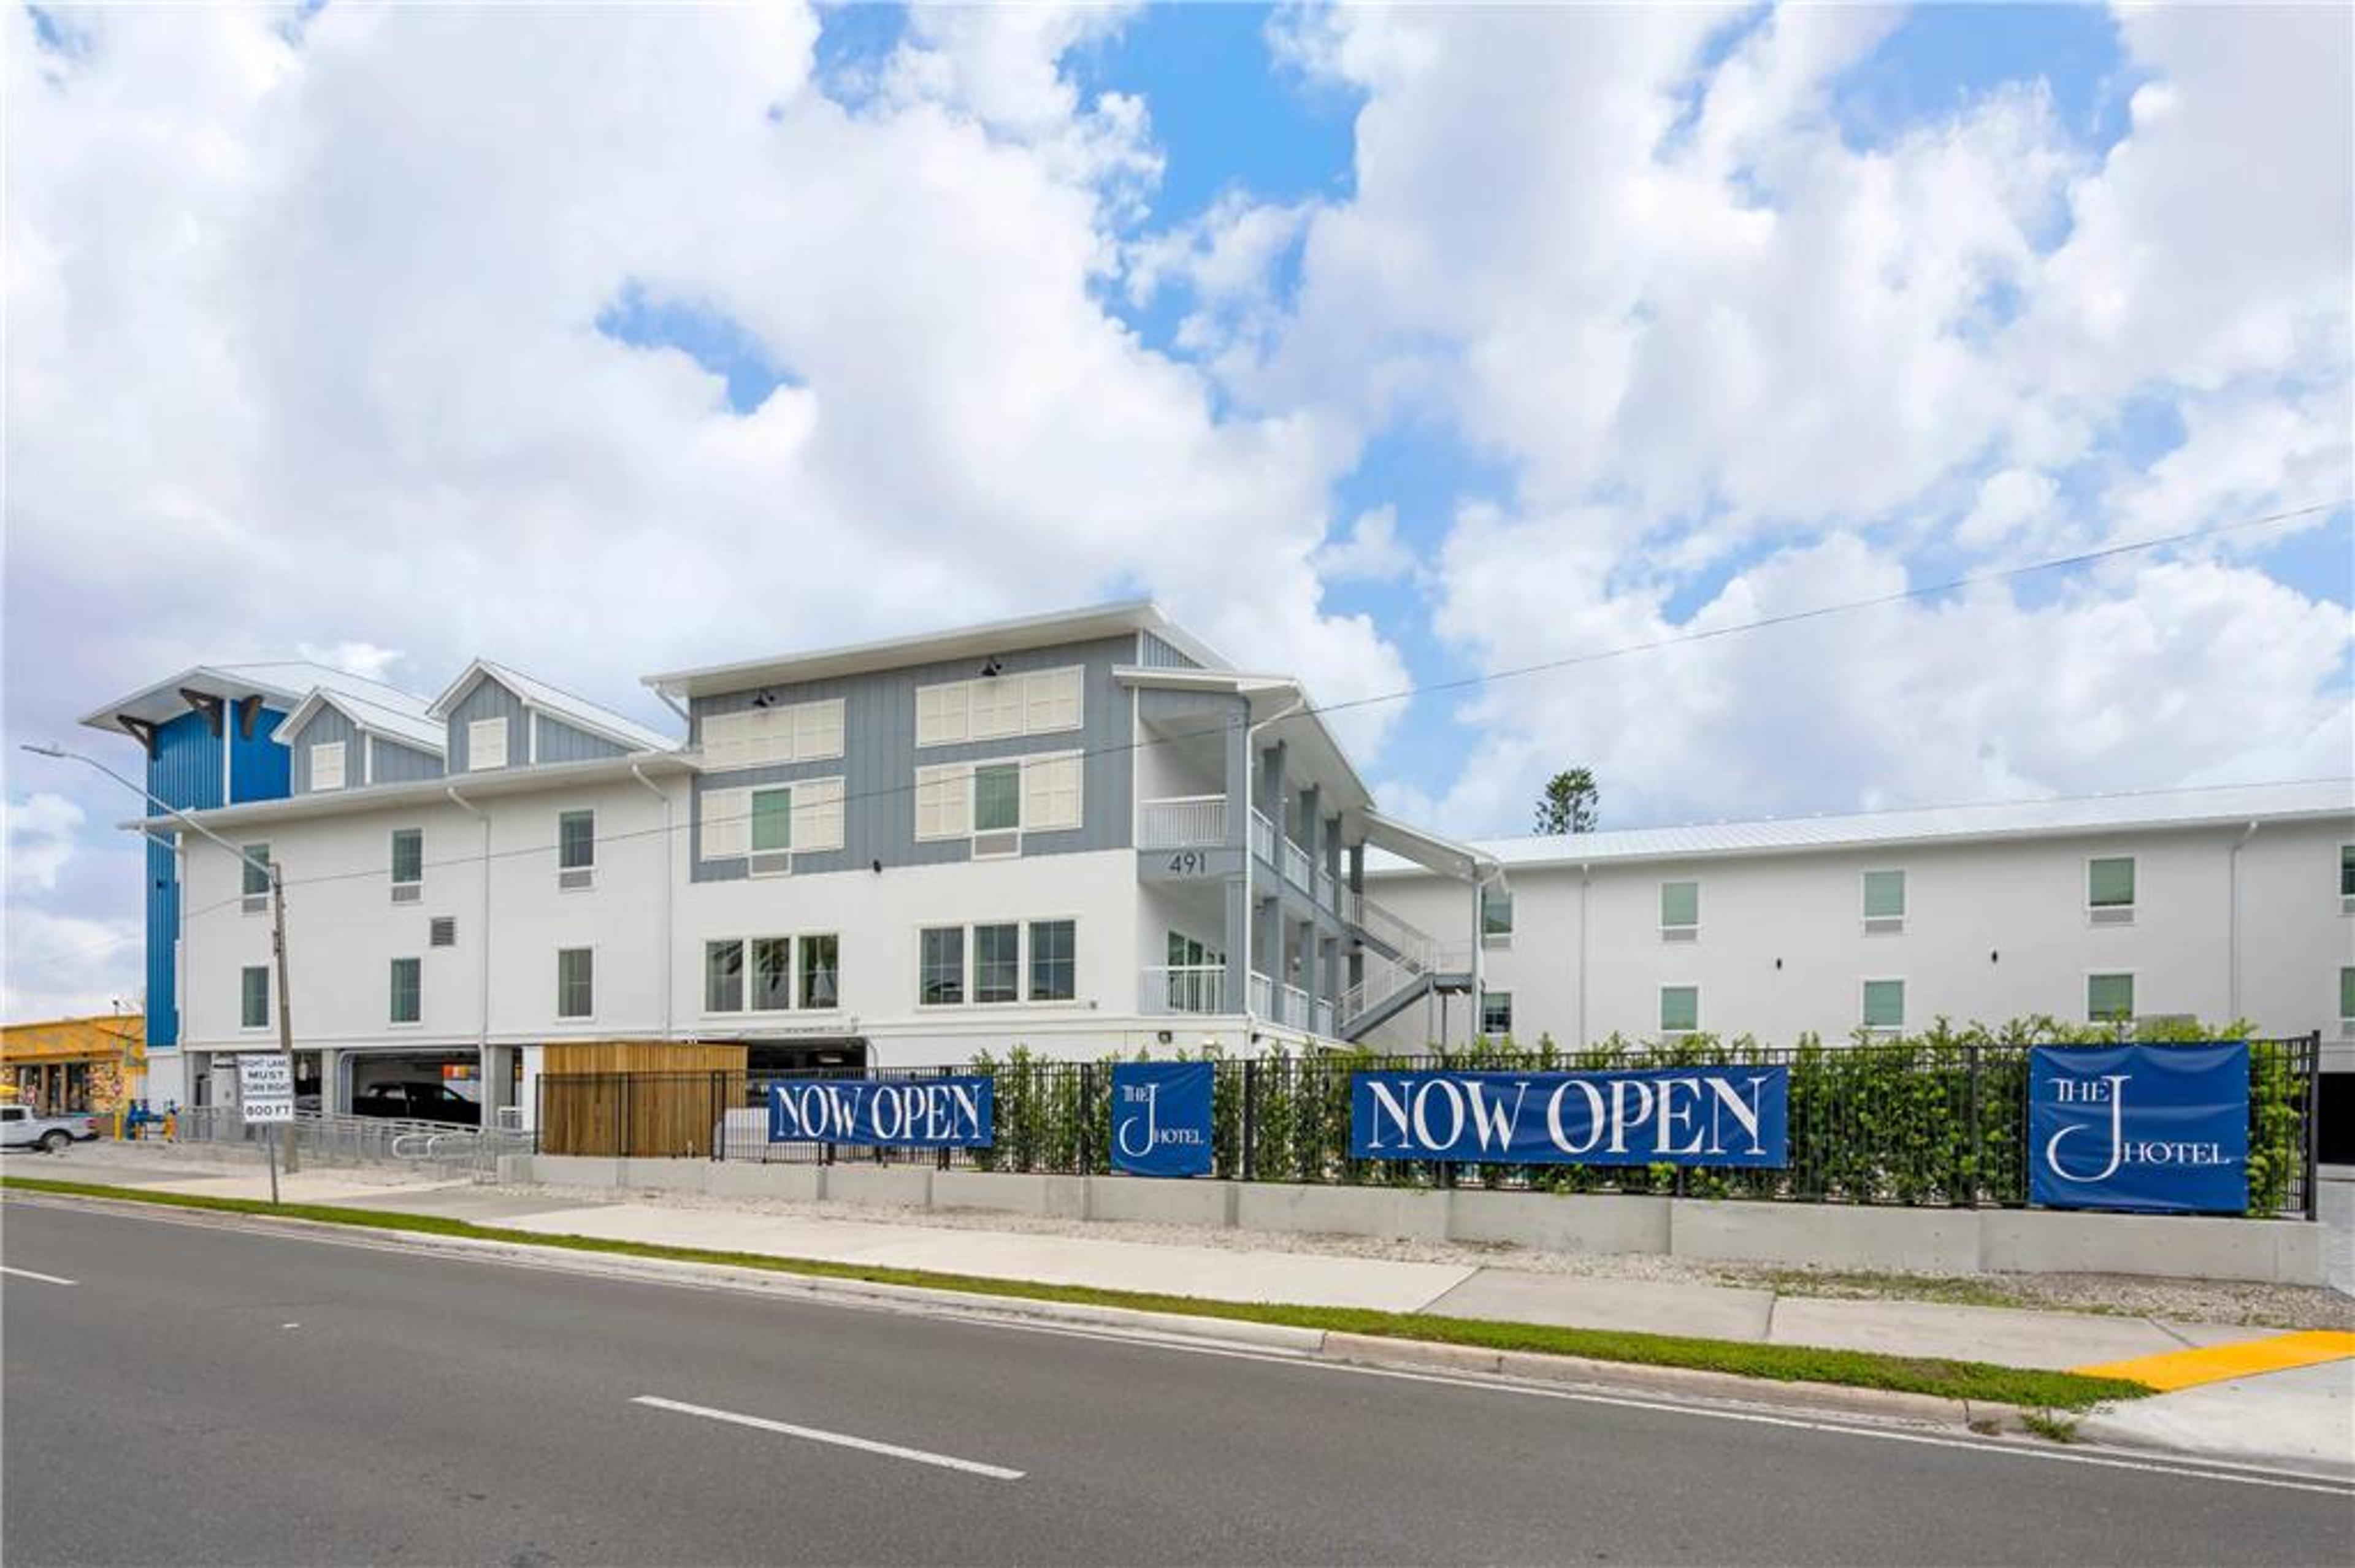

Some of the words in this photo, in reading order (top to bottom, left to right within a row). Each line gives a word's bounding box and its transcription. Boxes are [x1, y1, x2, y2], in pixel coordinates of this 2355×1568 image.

[1169, 852, 1206, 874] 491
[1122, 1084, 1150, 1102] THE
[2046, 1077, 2110, 1103] THE
[275, 1106, 289, 1114] FT
[776, 1085, 862, 1138] NOW
[871, 1084, 982, 1139] OPEN
[1119, 1082, 1160, 1157] J
[1366, 1079, 1531, 1153] NOW
[1547, 1077, 1770, 1155] OPEN
[1154, 1128, 1204, 1145] HOTEL
[2047, 1075, 2132, 1183] J
[2123, 1142, 2232, 1165] HOTEL
